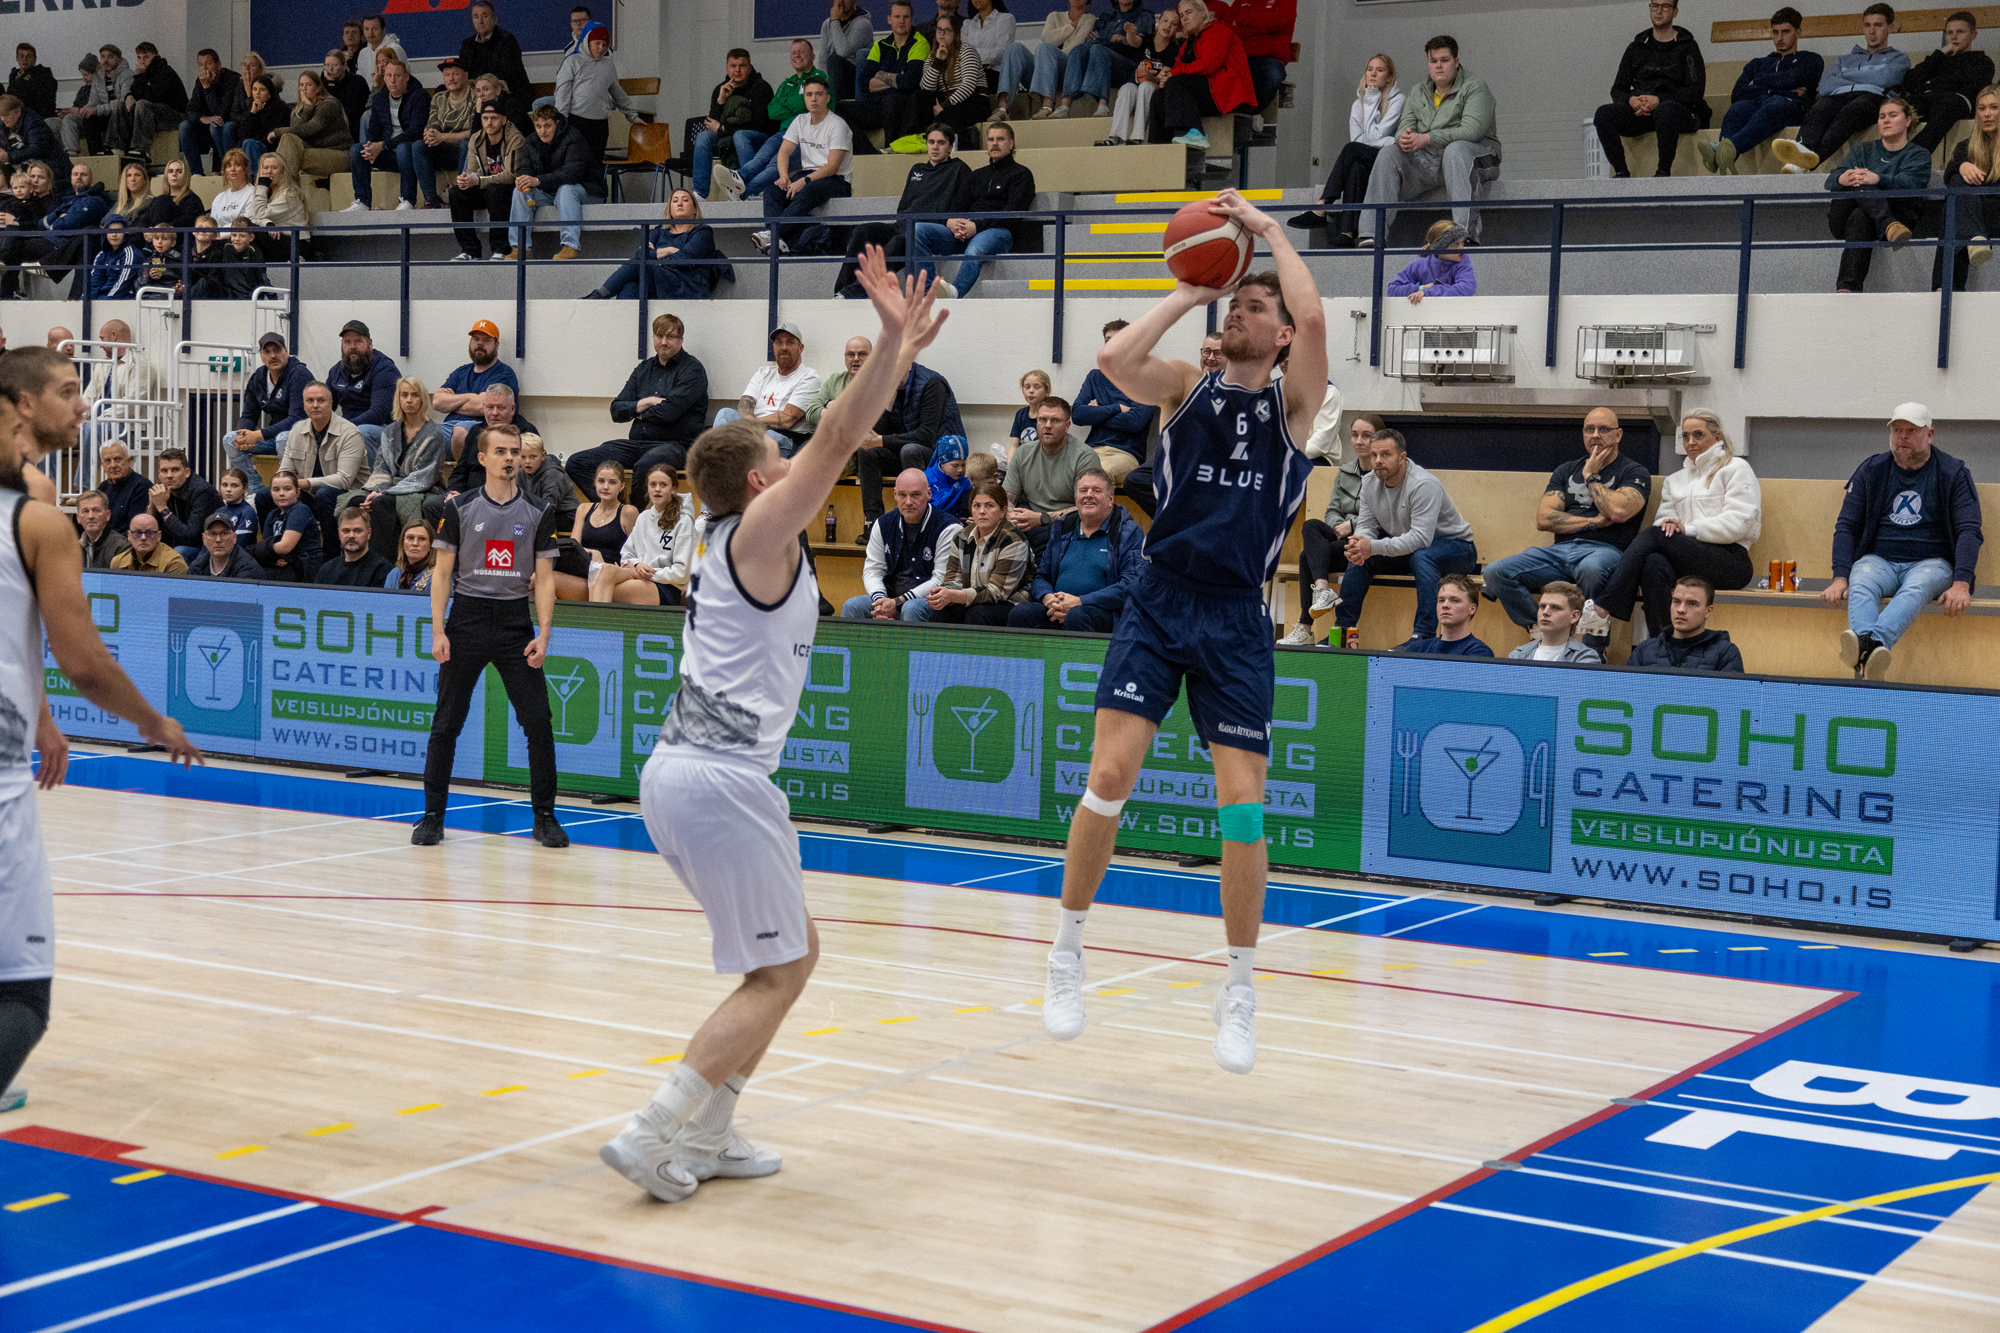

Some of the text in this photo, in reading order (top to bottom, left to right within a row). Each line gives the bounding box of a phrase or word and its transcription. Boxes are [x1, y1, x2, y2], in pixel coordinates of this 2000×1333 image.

[1236, 412, 1248, 435] 6
[1196, 464, 1264, 491] BLUE
[273, 659, 439, 695] CATERIN
[272, 727, 426, 758] WWW.SOHO.
[1574, 698, 1898, 778] SOHO
[1573, 768, 1894, 823] CATERING
[1571, 856, 1891, 909] WWW.SOHO.IS
